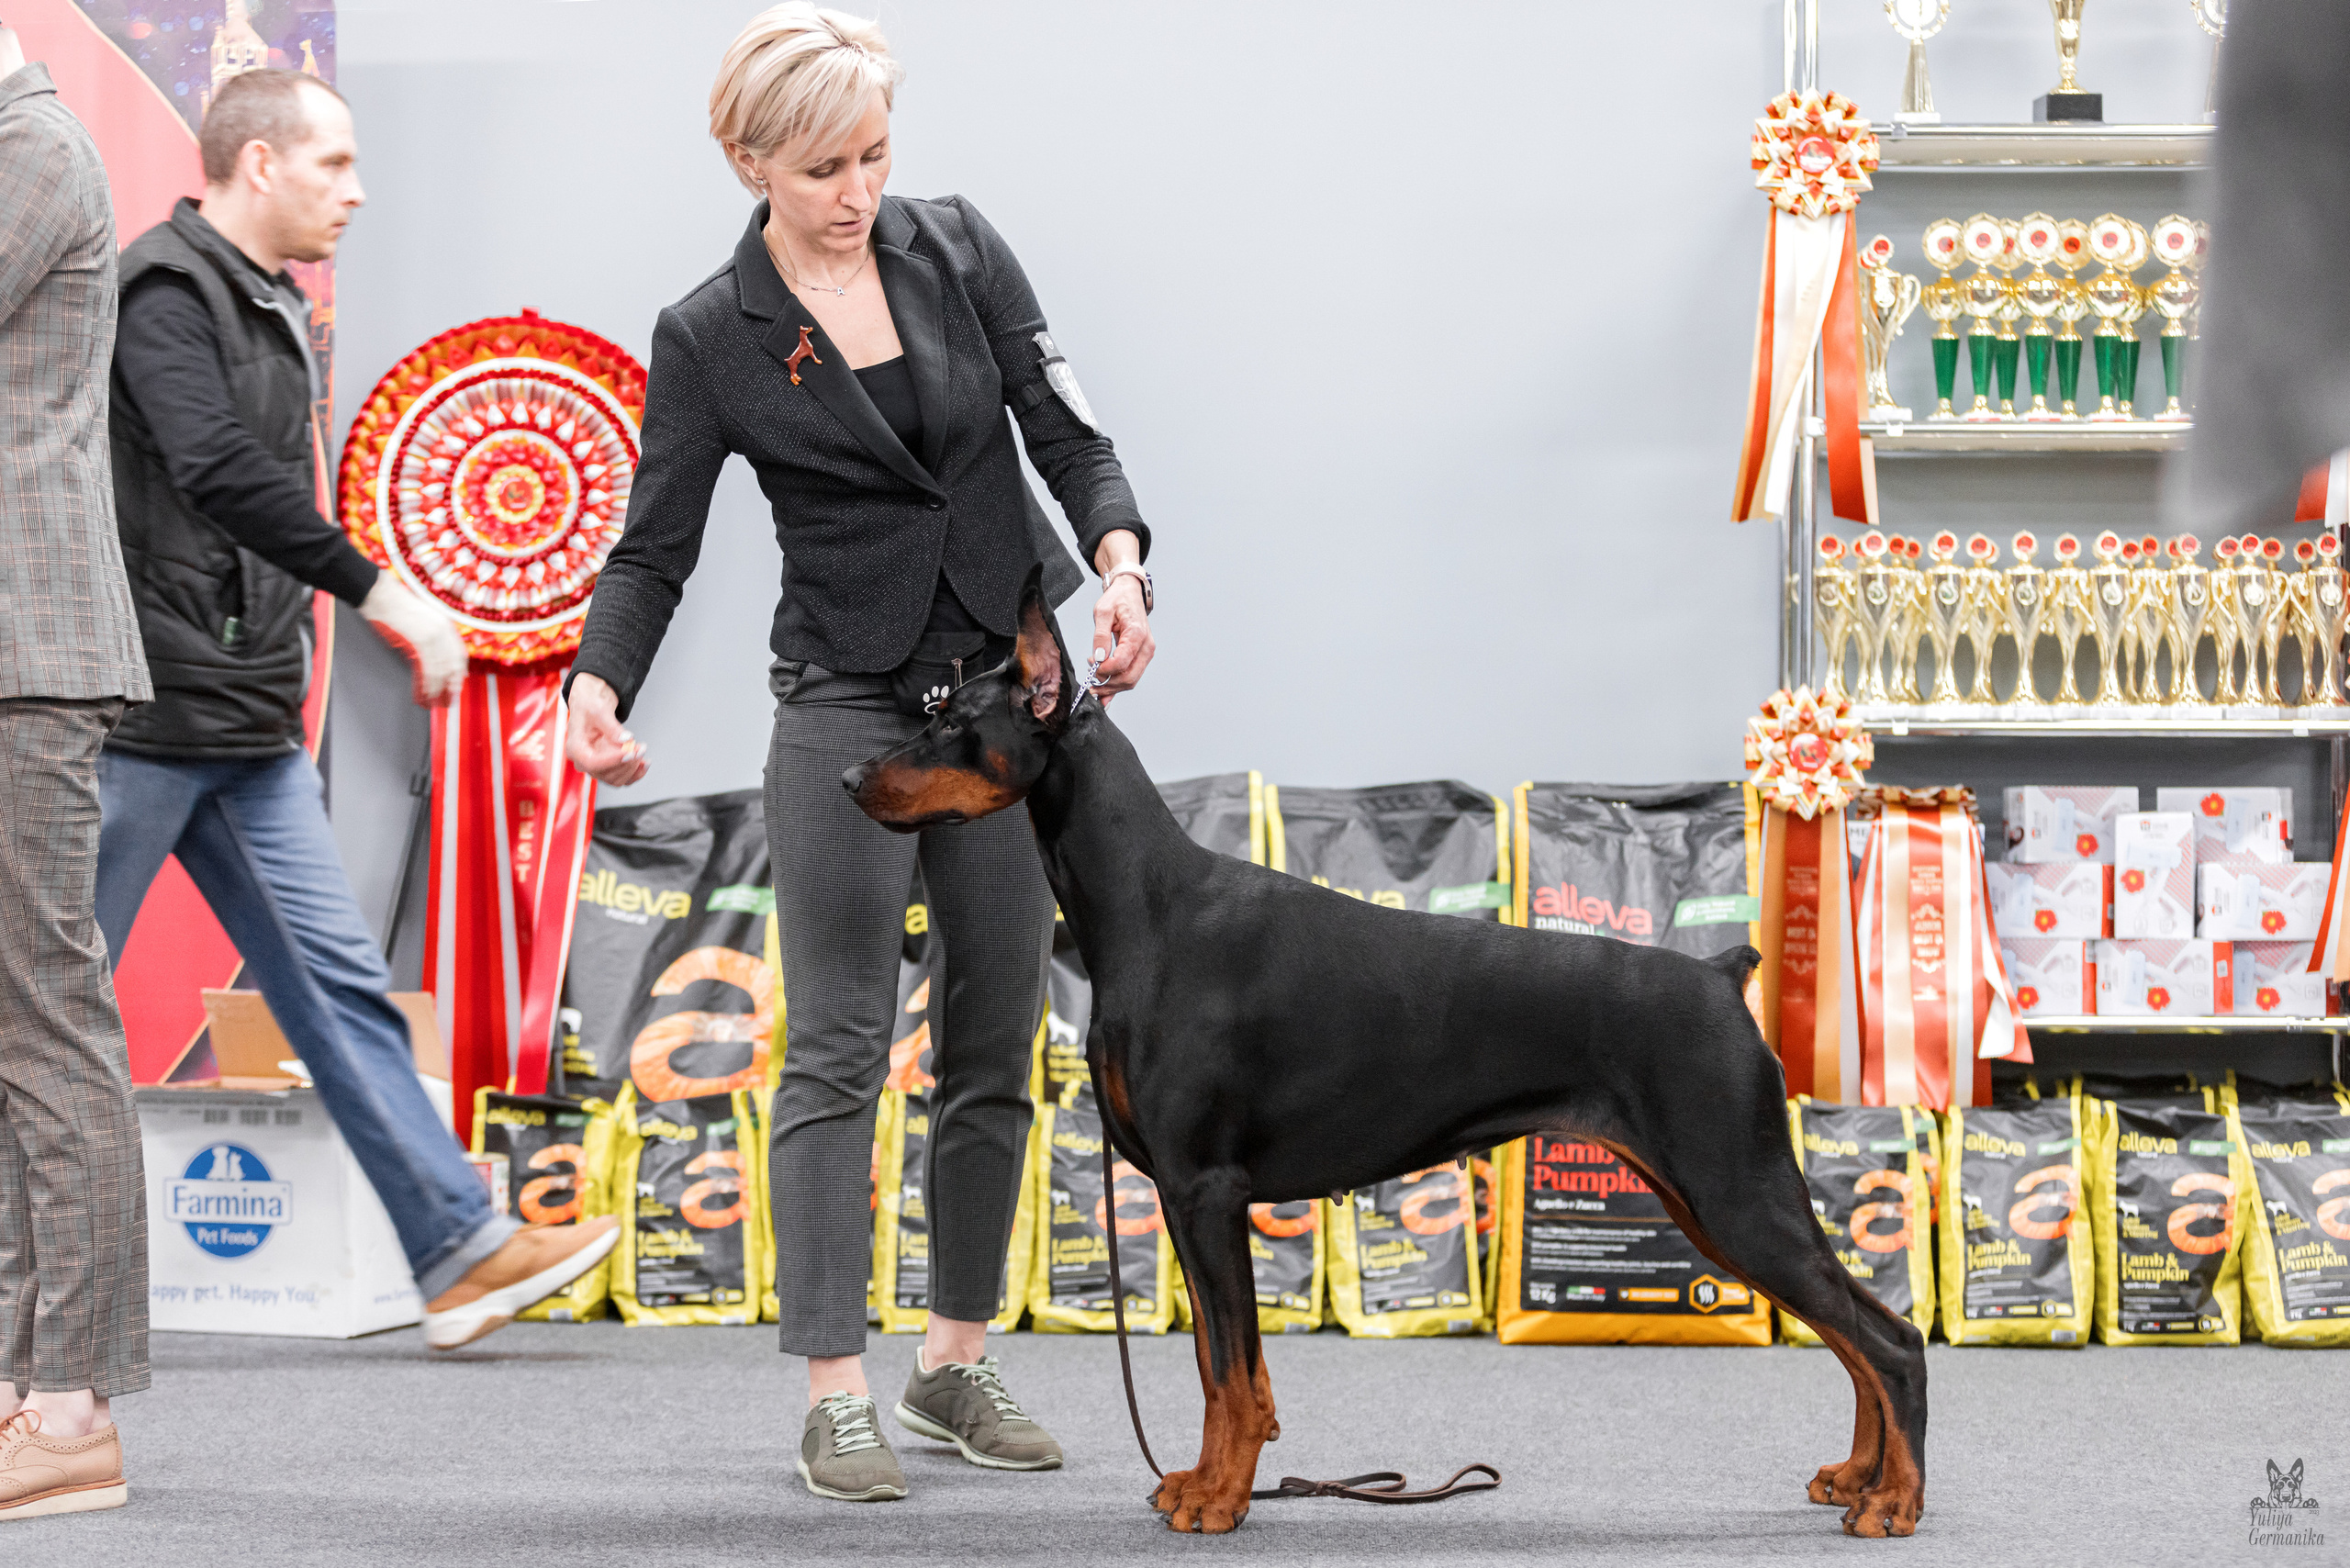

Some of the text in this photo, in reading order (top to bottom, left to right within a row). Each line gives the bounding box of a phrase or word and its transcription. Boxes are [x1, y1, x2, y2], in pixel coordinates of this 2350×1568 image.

[576, 868, 692, 919] alleva
[1533, 881, 1653, 935] alleva
[1534, 916, 1595, 935] natural
[1964, 1131, 2026, 1157] alleva
[2119, 1131, 2177, 1155] alleva
[2251, 1141, 2311, 1159] alleva
[173, 1185, 282, 1216] Farmina
[197, 1227, 259, 1246] Pet Foods
[1967, 1251, 2031, 1271] Pumpkin
[2121, 1252, 2178, 1268] Lamb &
[2278, 1241, 2321, 1261] Lamb
[2121, 1265, 2189, 1283] Pumpkin
[2279, 1254, 2348, 1274] Pumpkin
[151, 1287, 188, 1304] appy
[230, 1286, 278, 1305] Happy
